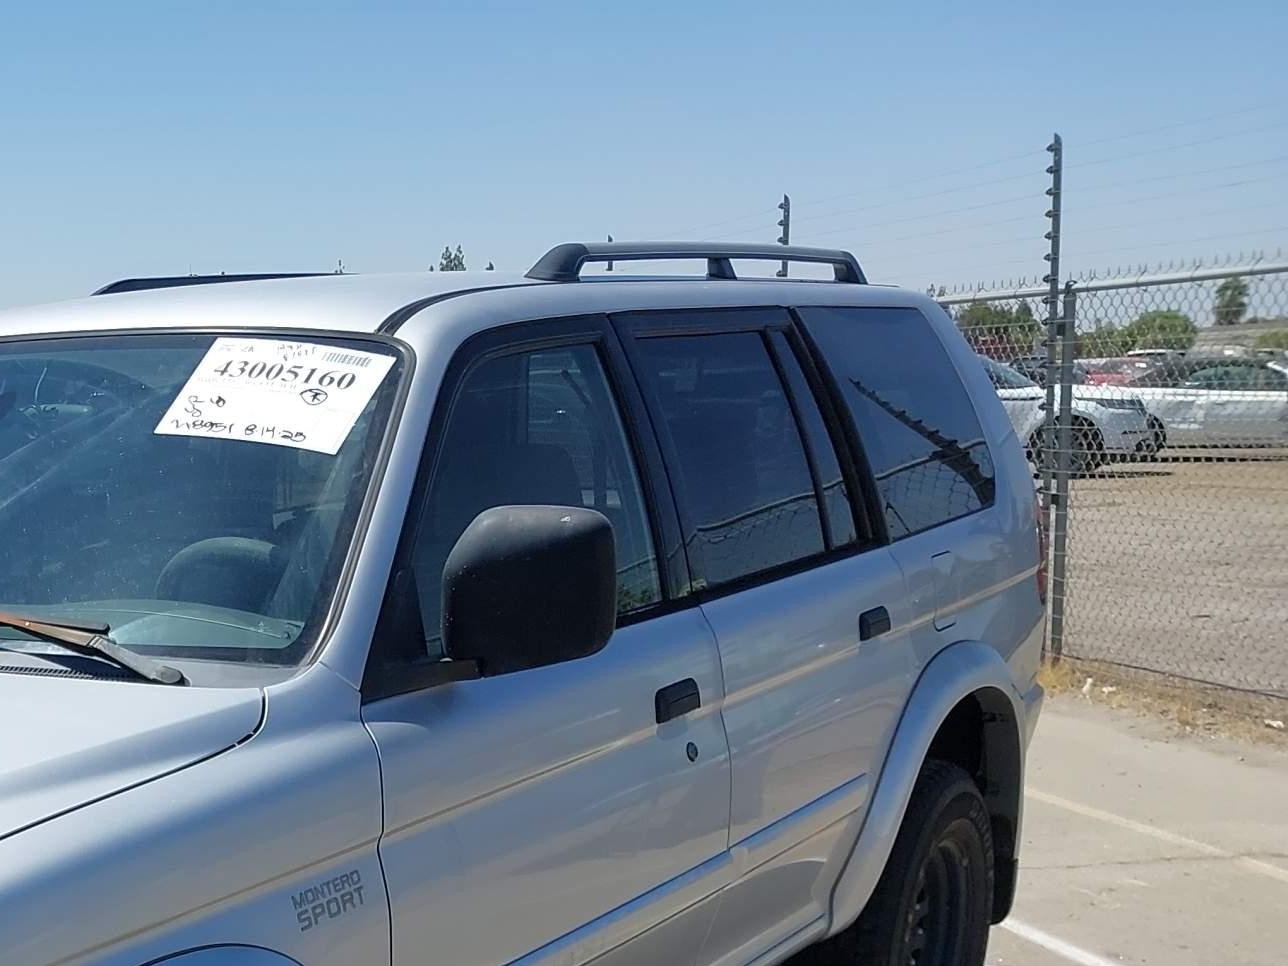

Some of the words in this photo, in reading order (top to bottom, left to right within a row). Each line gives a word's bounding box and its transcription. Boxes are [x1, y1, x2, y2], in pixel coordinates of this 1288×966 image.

[213, 360, 357, 391] 43005160
[291, 870, 361, 910] MONTERO
[296, 886, 364, 932] SPORT
